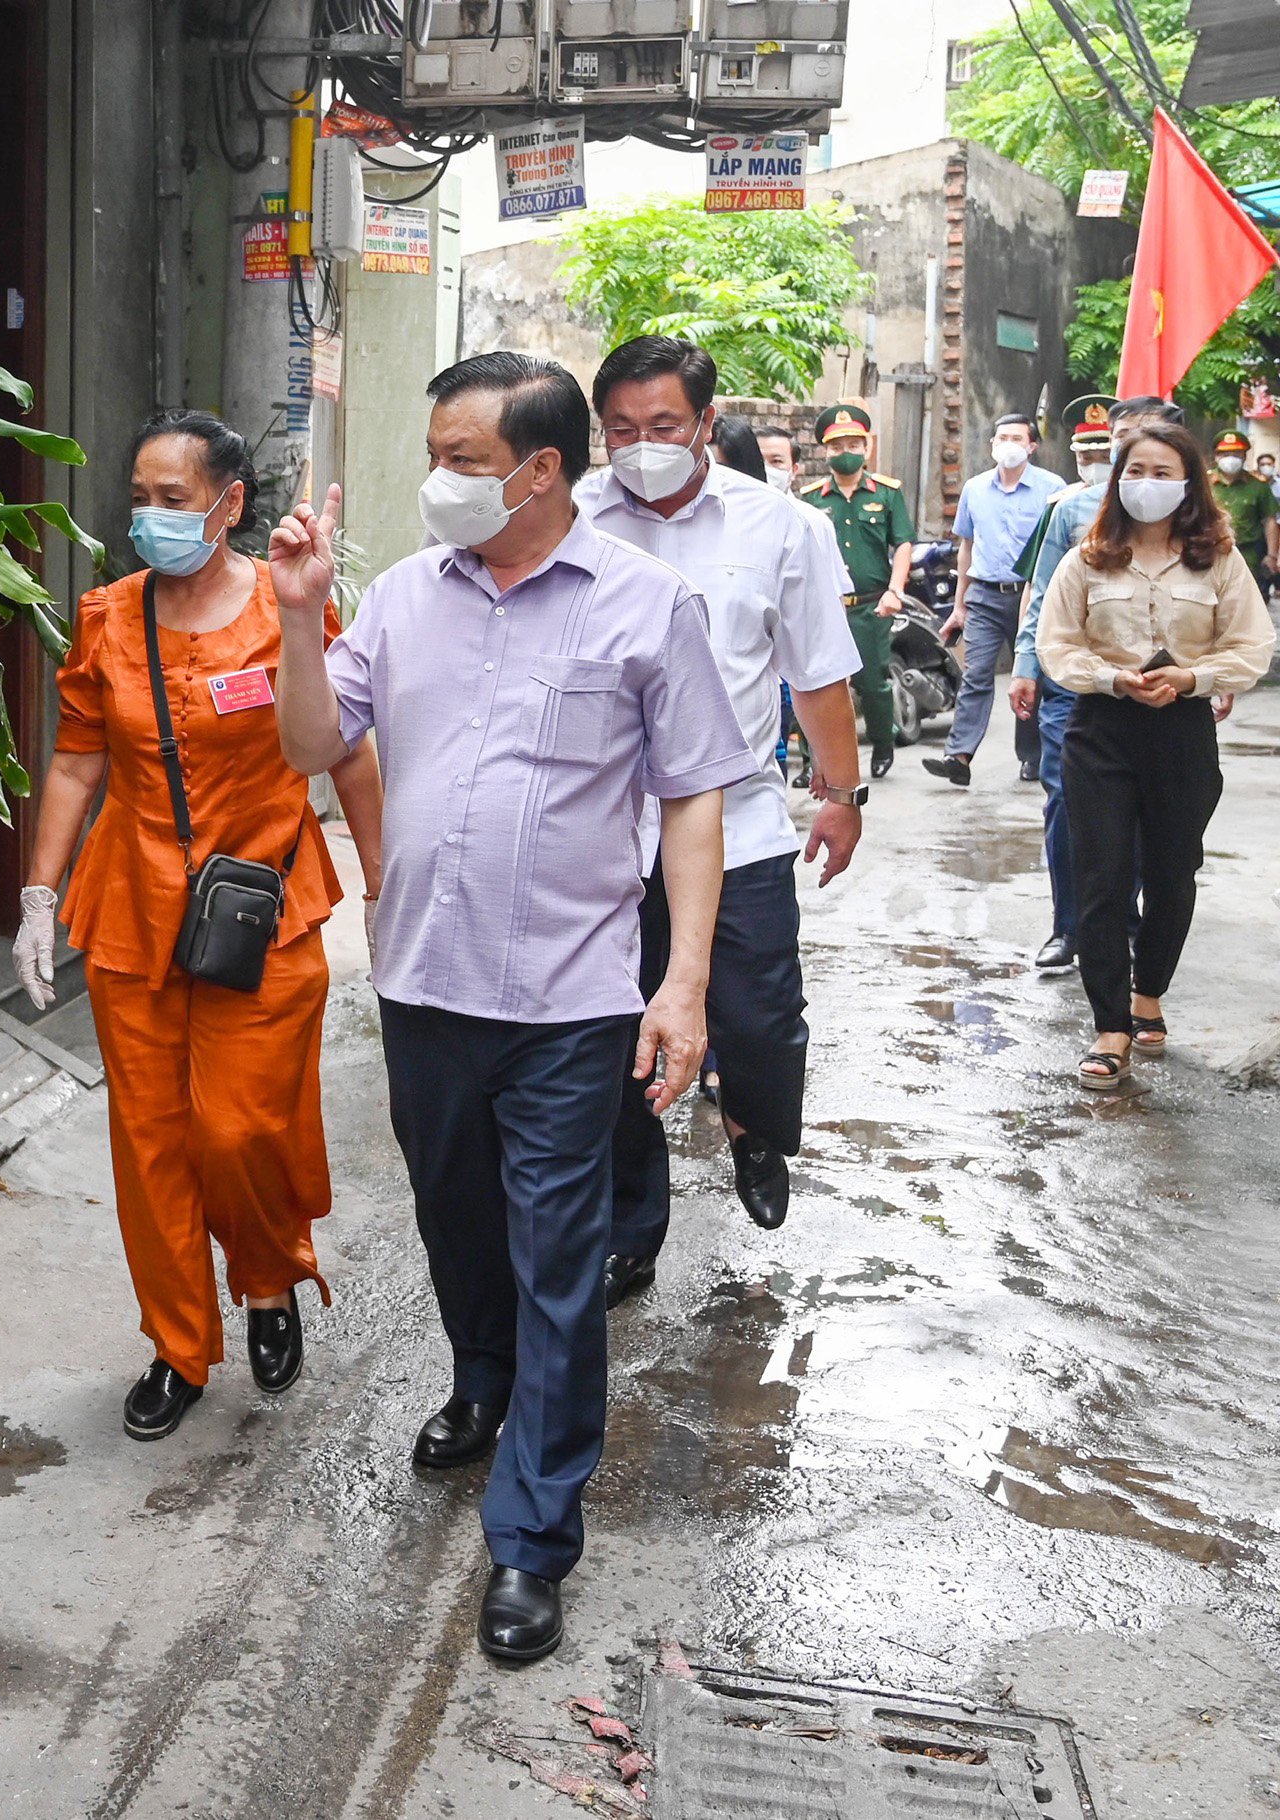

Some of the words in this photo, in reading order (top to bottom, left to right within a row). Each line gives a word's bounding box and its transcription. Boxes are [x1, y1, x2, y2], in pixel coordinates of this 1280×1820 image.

[499, 133, 541, 151] INTERNET
[709, 151, 743, 176] LẮP
[748, 158, 802, 180] MẠNG
[716, 177, 750, 187] TRUYỀN
[753, 178, 777, 187] HÌNH
[505, 188, 577, 215] 0866.077.871
[706, 190, 802, 209] 0967.469.963
